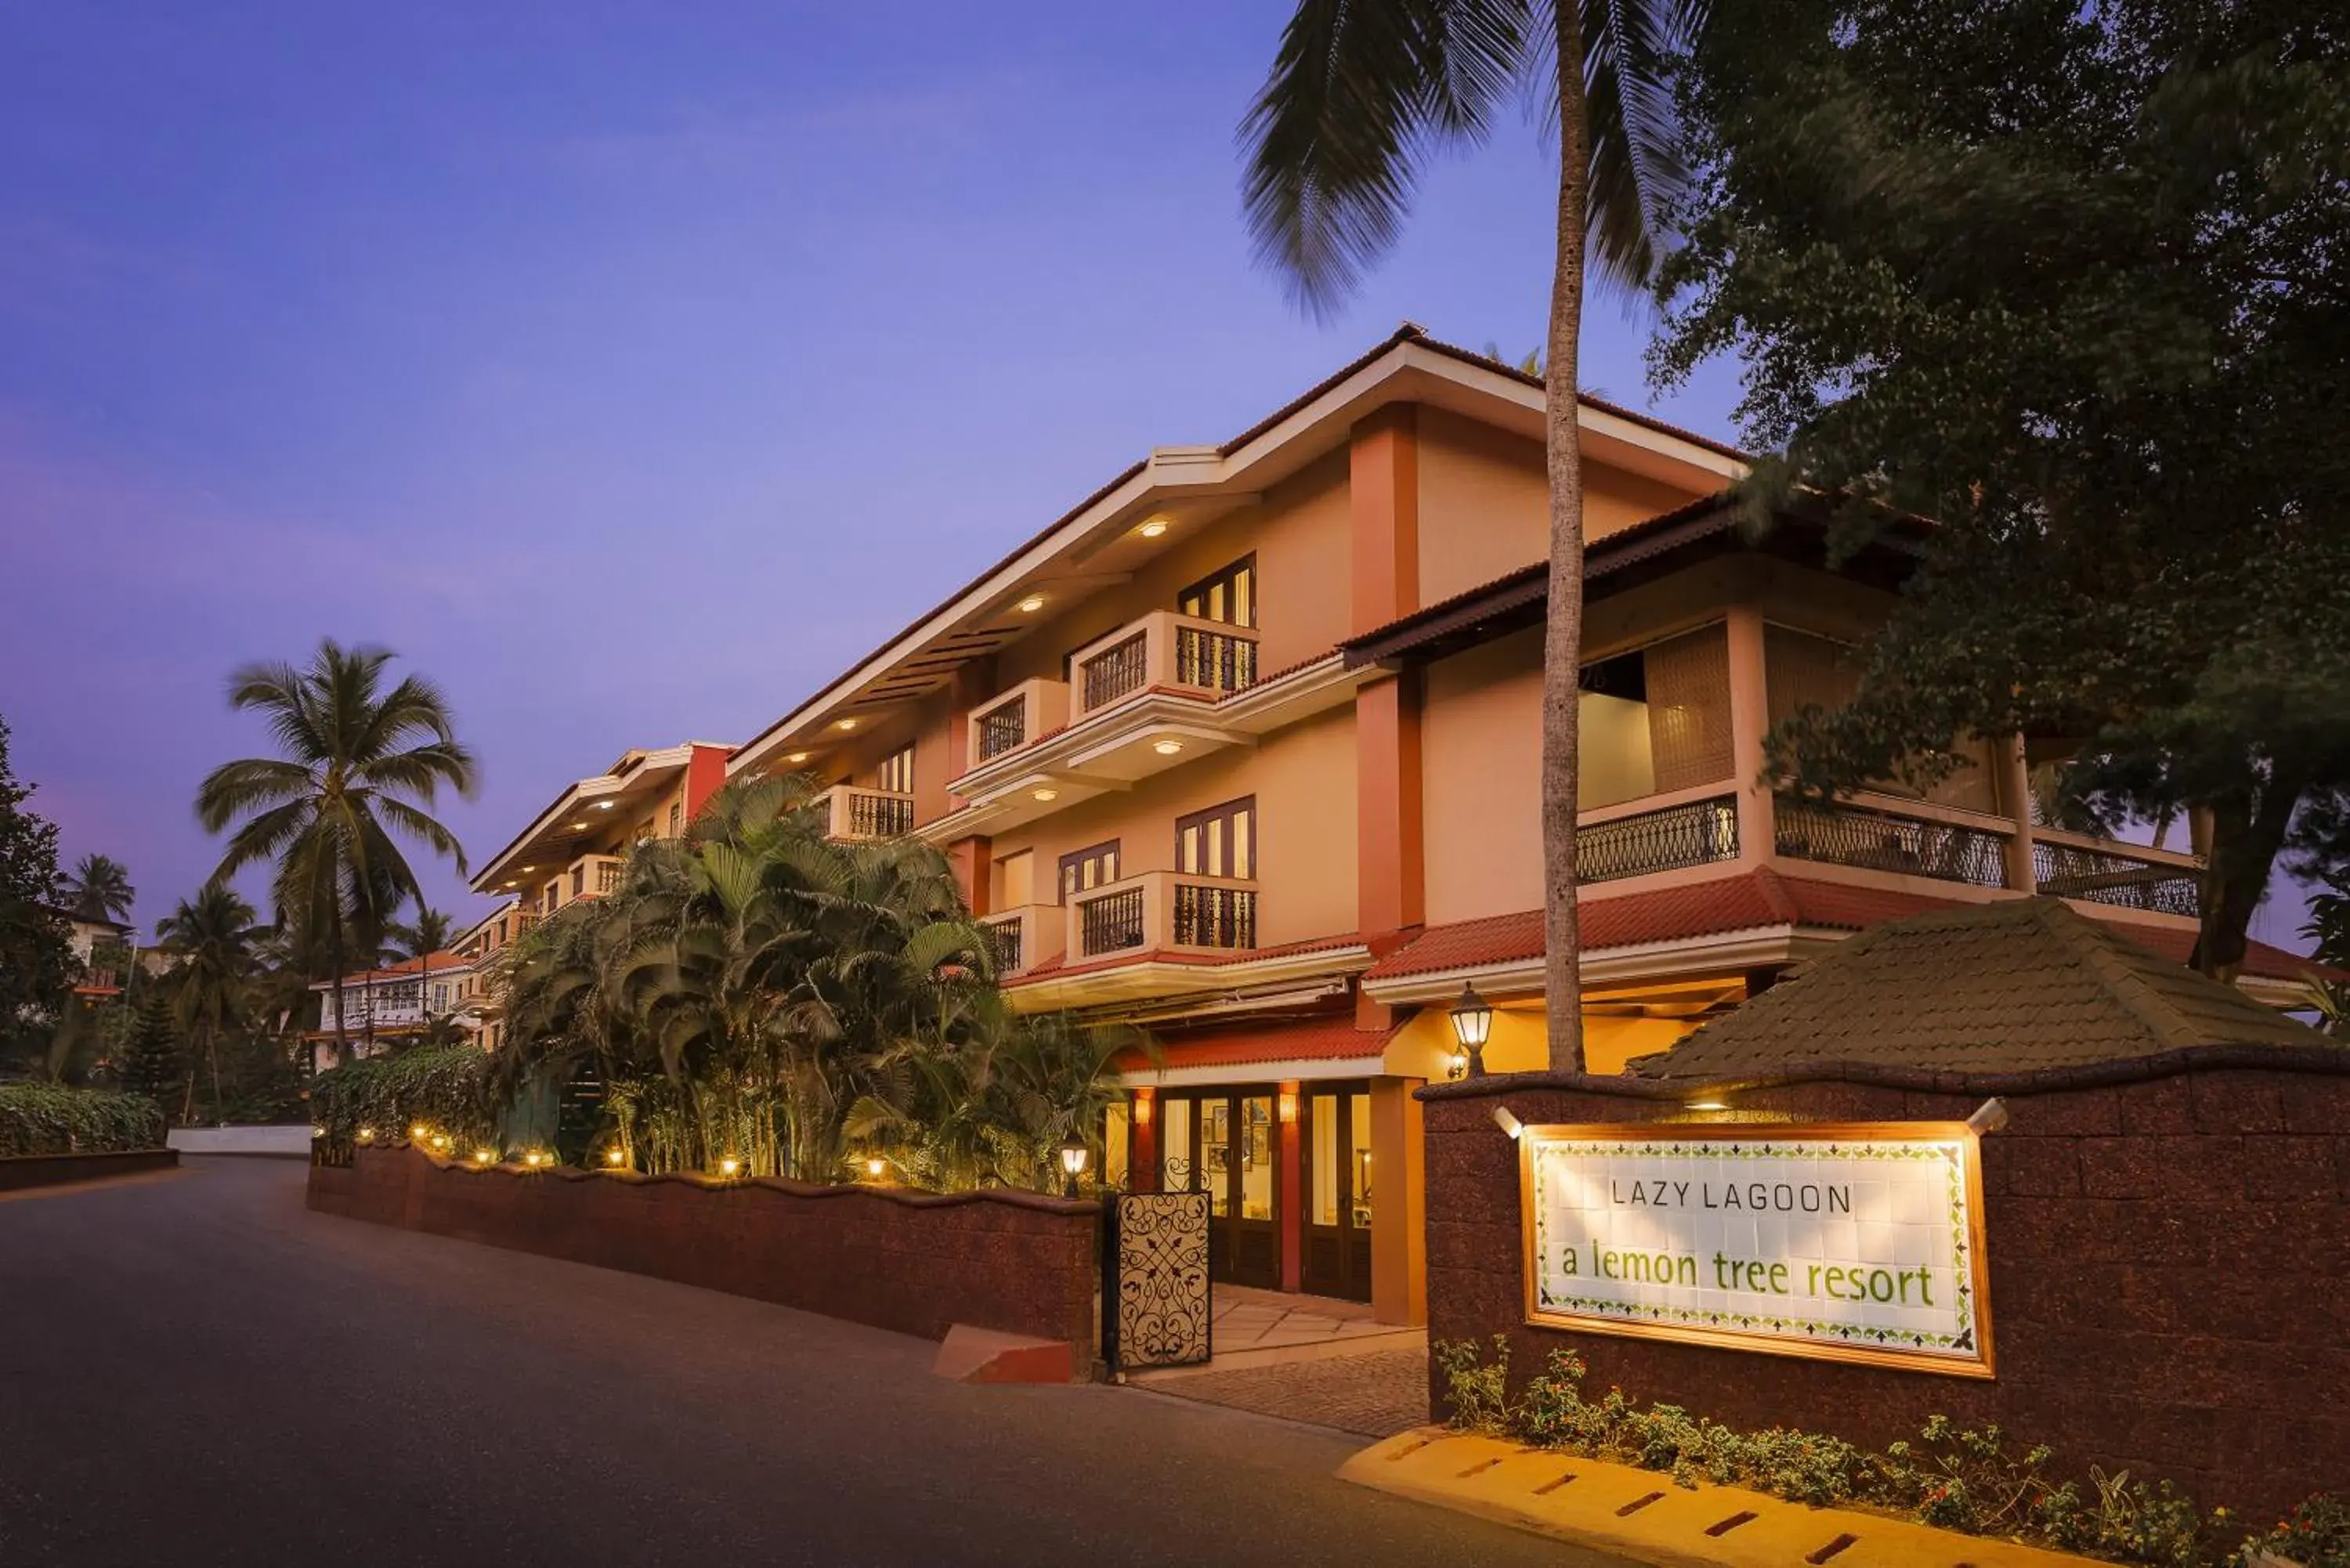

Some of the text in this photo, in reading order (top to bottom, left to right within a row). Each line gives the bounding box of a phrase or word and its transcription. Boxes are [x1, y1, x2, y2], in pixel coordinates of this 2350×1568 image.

[1612, 1180, 1851, 1214] LAZY LAGOON
[1562, 1238, 1935, 1306] a lemon tree resort
